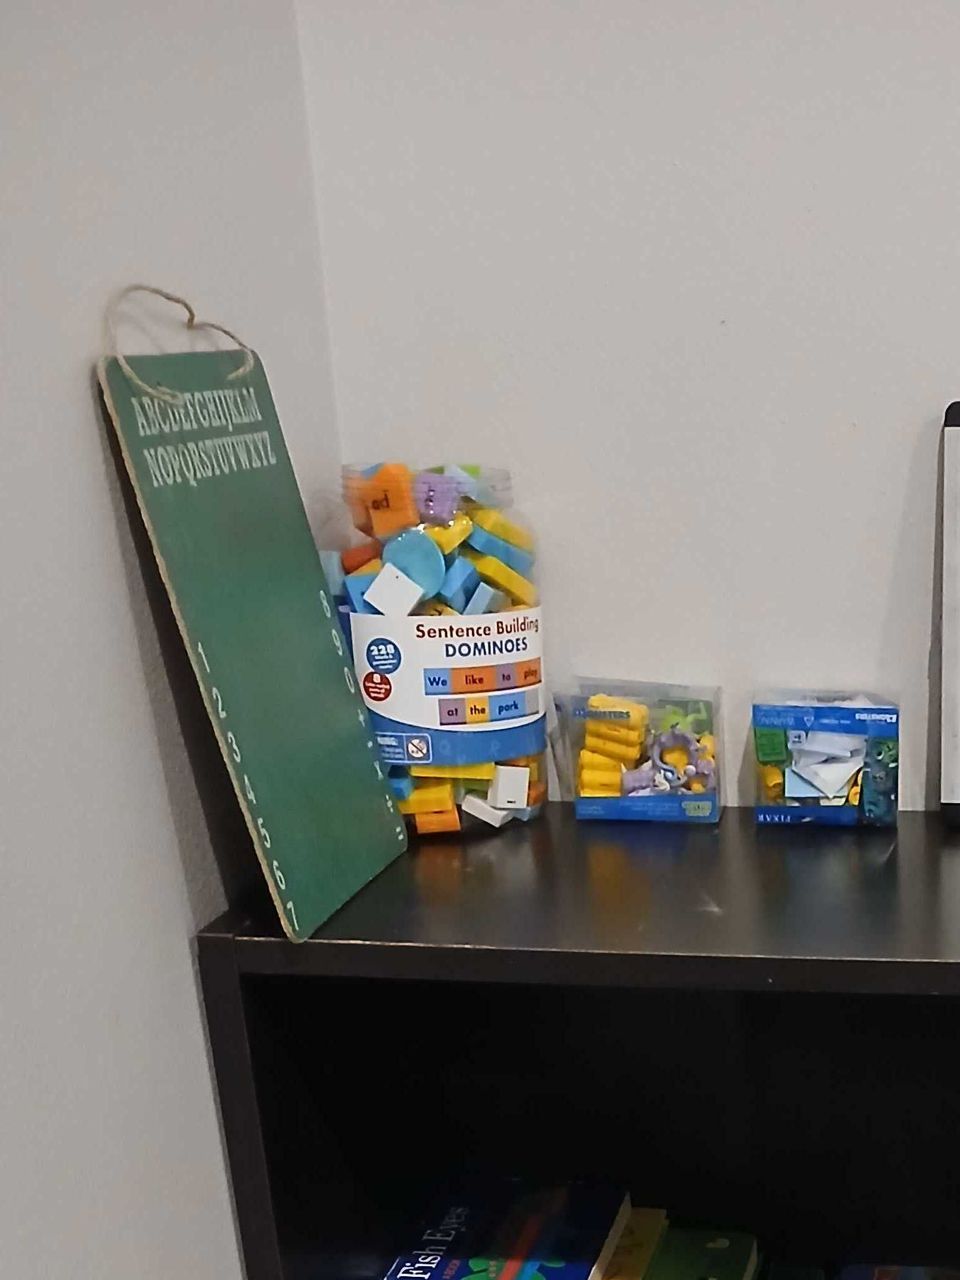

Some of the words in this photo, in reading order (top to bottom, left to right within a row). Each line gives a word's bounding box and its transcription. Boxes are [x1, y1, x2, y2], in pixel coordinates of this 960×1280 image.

[143, 431, 277, 487] NOPQRSTUVWXYZ
[319, 590, 331, 618] 8
[332, 629, 343, 656] 9
[415, 623, 491, 639] Sentence
[496, 616, 540, 636] Building
[197, 642, 210, 673] 1
[445, 637, 528, 658] DOMINOES
[428, 676, 448, 688] We
[464, 673, 484, 686] like
[501, 673, 511, 683] to
[523, 665, 538, 679] play
[212, 687, 227, 718] 2
[447, 708, 459, 718] at
[470, 704, 486, 716] the
[497, 699, 520, 715] park
[227, 731, 241, 763] 3
[243, 774, 257, 804] 4
[257, 817, 271, 849] 5
[273, 860, 286, 890] 6
[287, 901, 299, 931] 7
[397, 1243, 446, 1280] Fish
[422, 1206, 470, 1240] Eyes
